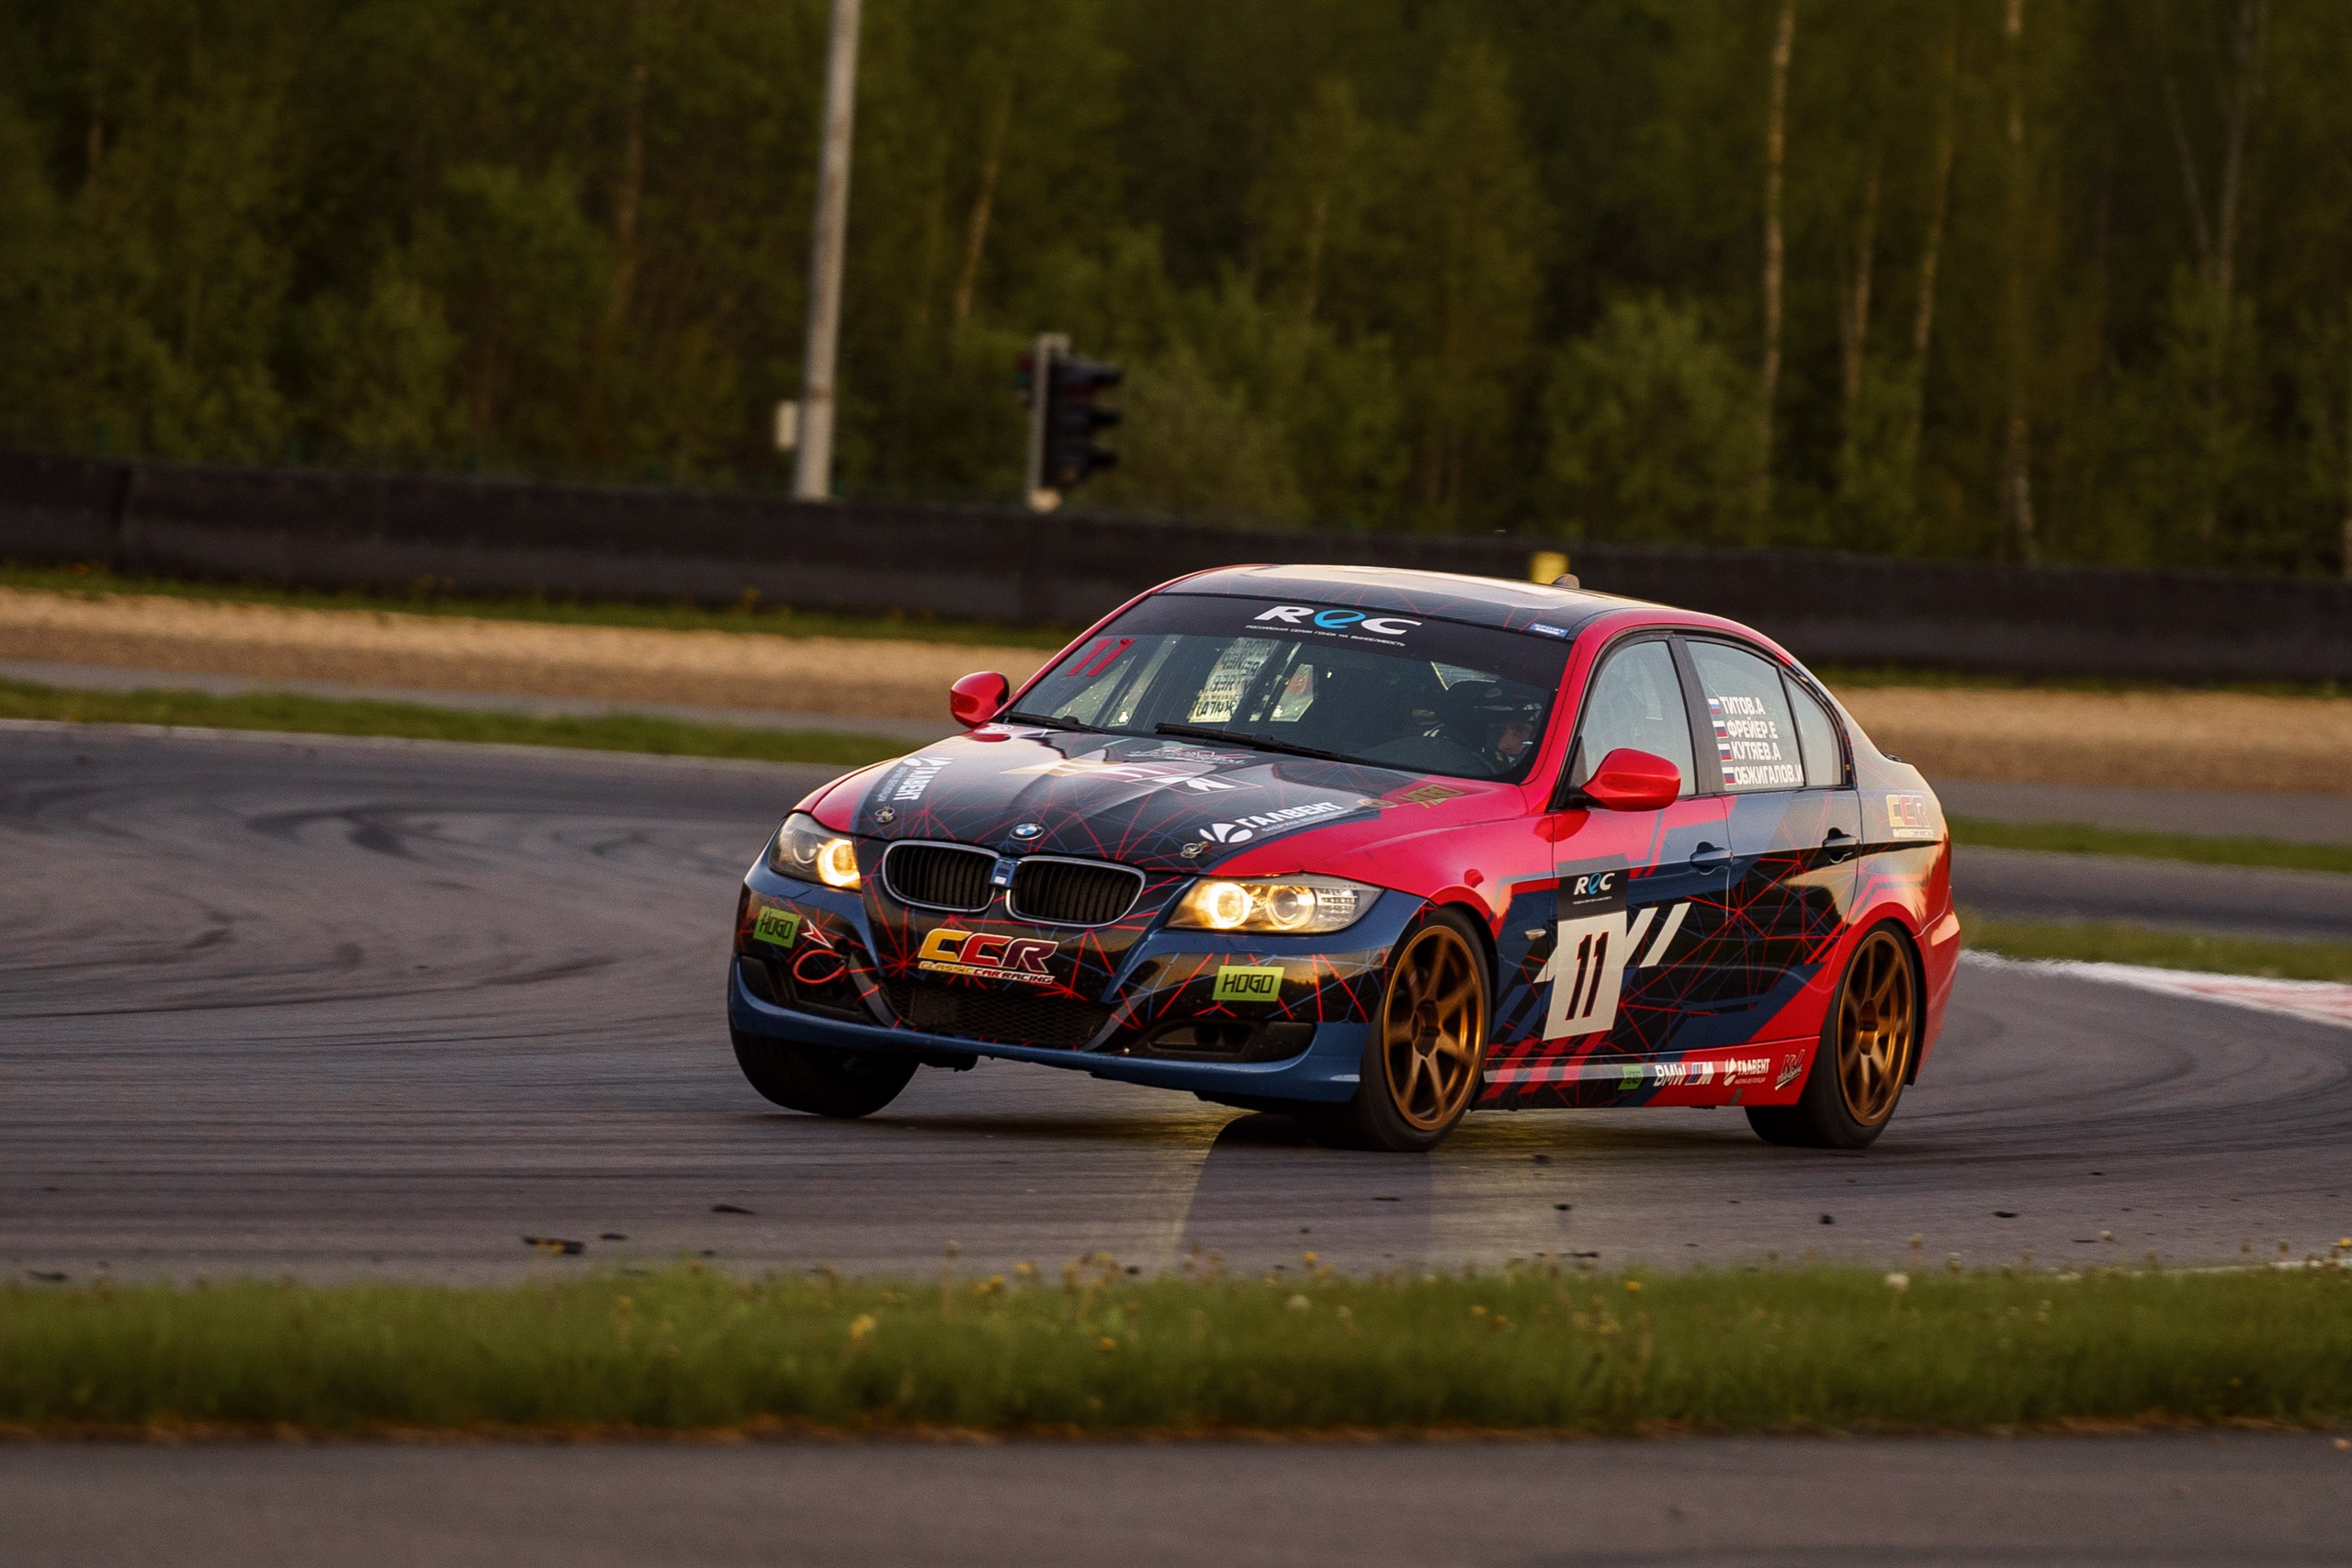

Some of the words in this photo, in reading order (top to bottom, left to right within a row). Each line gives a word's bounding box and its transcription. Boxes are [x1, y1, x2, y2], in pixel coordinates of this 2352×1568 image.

[1066, 637, 1137, 677] 11
[1719, 696, 1766, 715] ТИТОВ.А
[1730, 741, 1781, 761] КУТЯЕВ.А
[1234, 801, 1344, 829] ГАЛВЕНТ
[1886, 794, 1931, 828] CCR
[759, 910, 795, 940] HOGO
[918, 928, 1059, 974] CCR
[919, 961, 974, 976] CLASSIC
[974, 968, 1001, 978] CAR
[1001, 970, 1056, 985] RACING
[1222, 974, 1274, 993] HOGO
[1565, 931, 1610, 1021] 11
[1654, 1064, 1687, 1087] BMW
